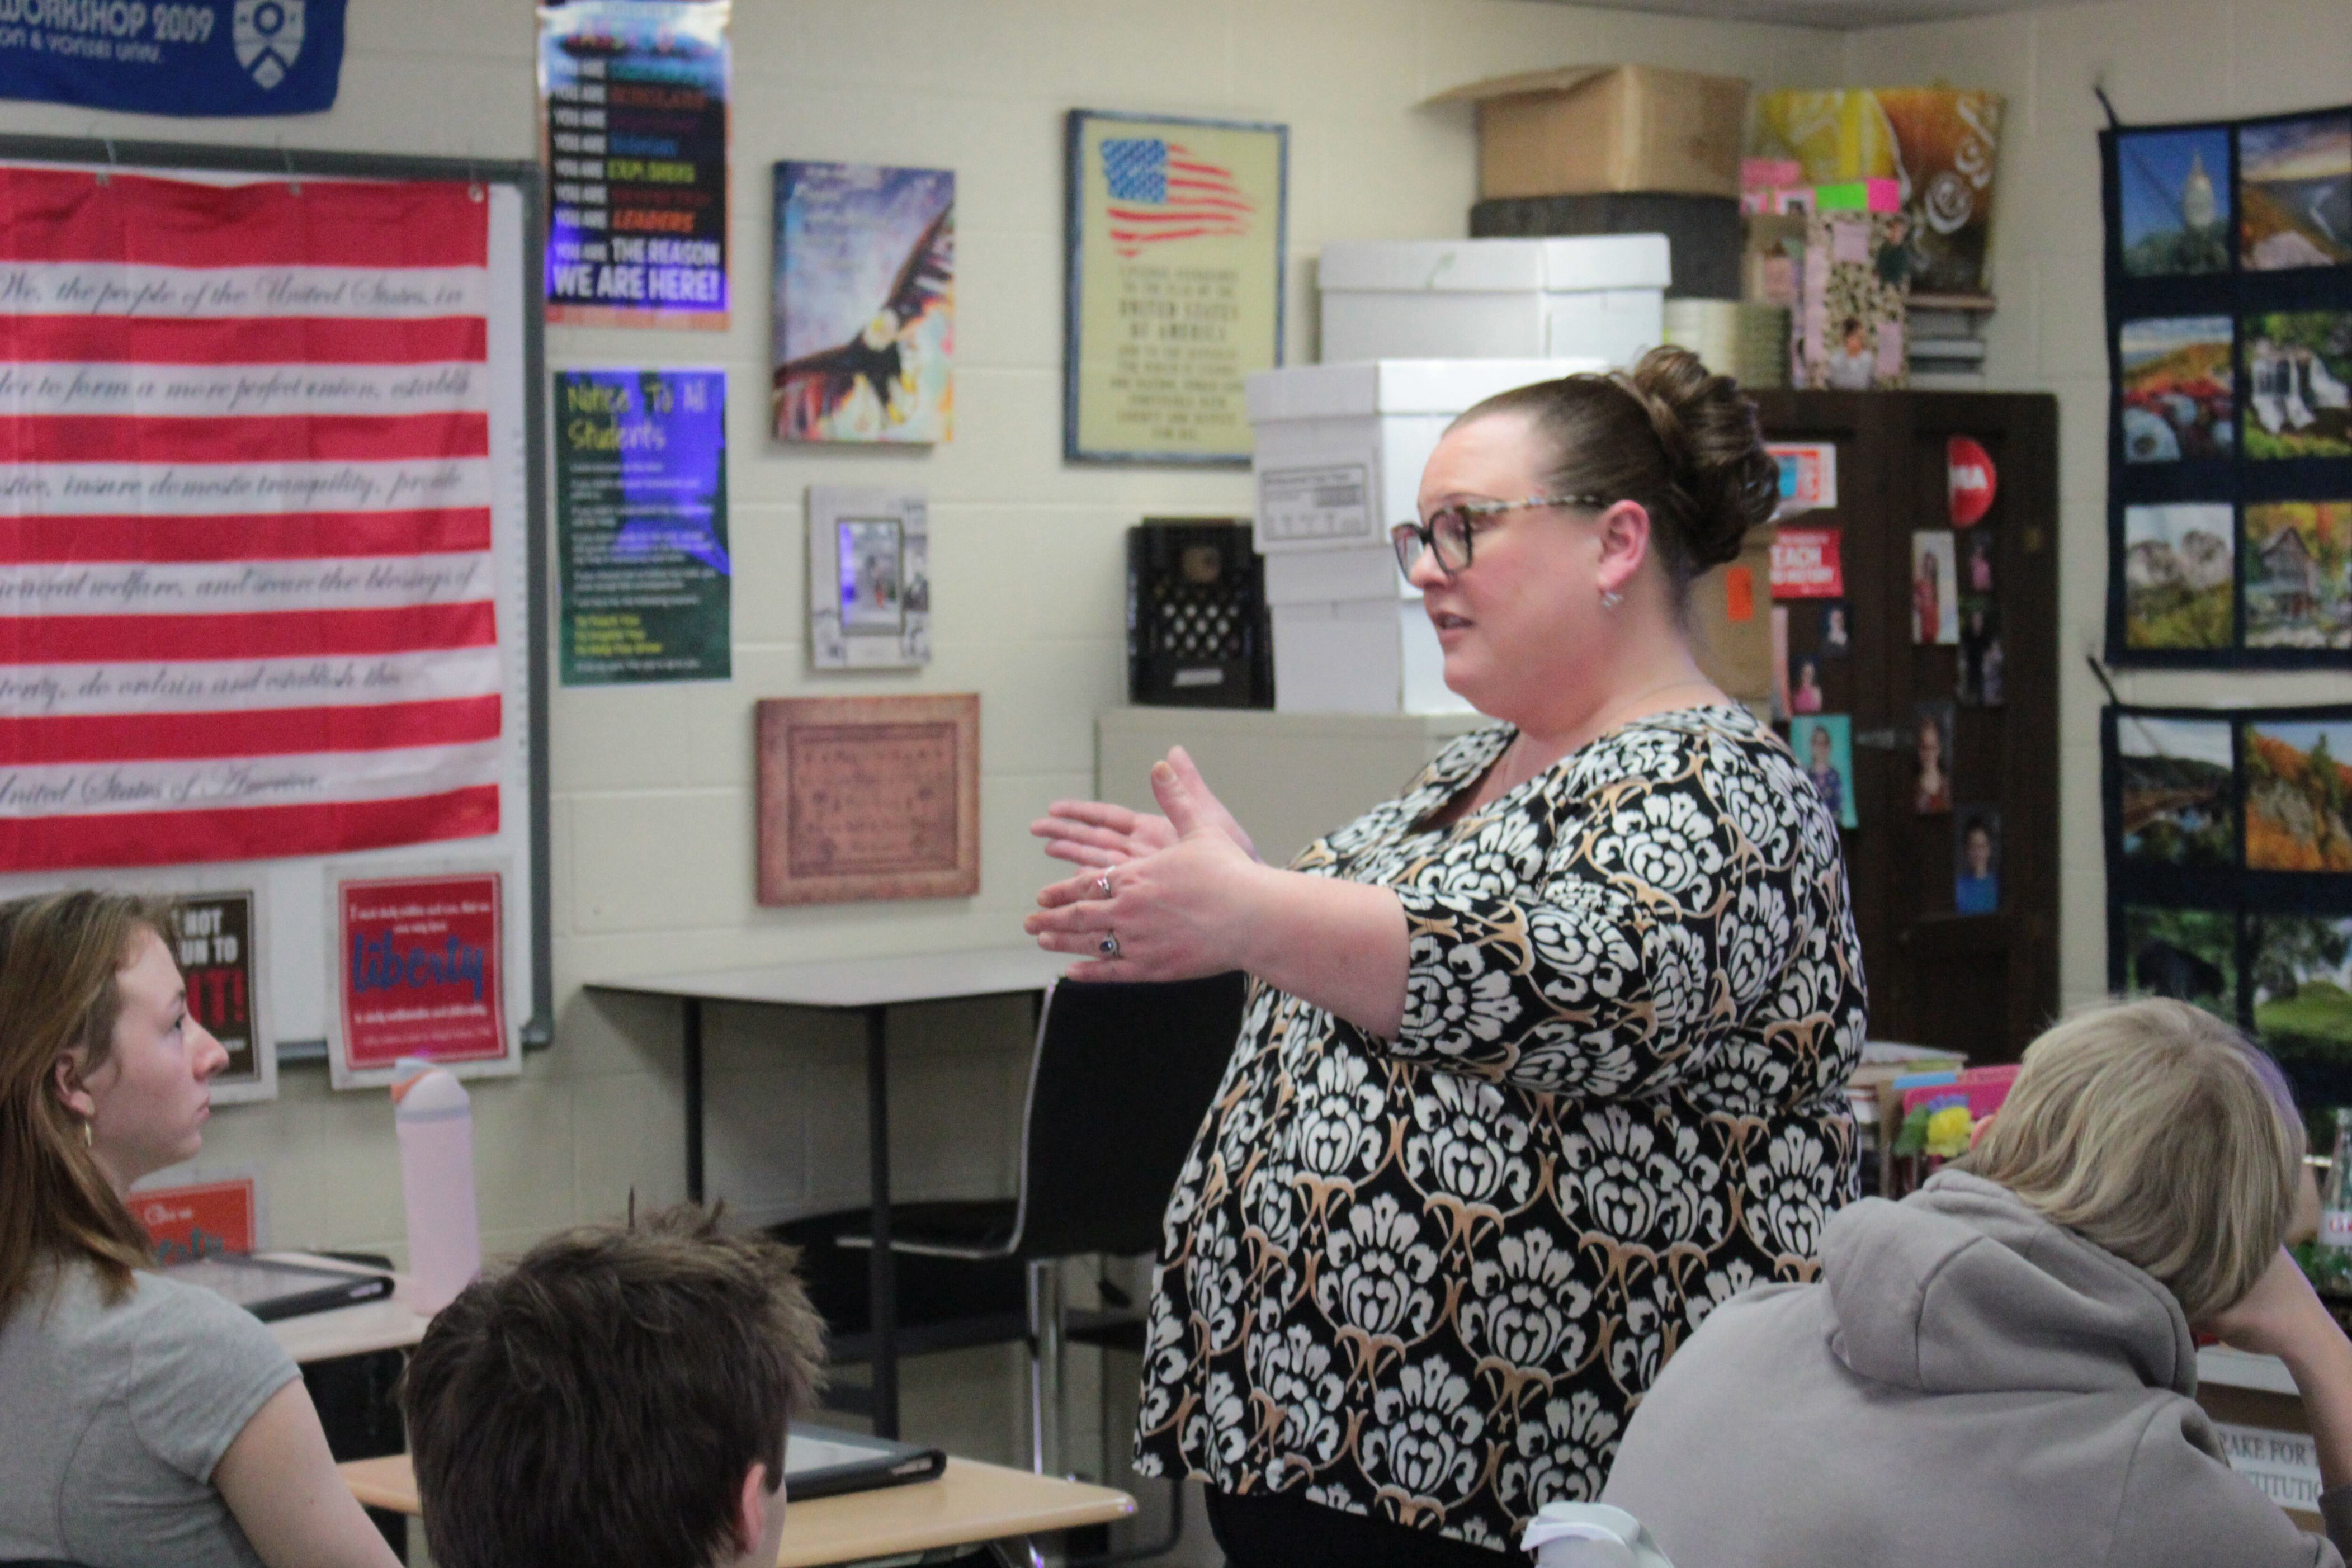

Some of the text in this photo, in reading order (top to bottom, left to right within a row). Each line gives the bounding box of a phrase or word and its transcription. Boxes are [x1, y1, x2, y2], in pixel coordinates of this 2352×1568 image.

[153, 4, 214, 43] 2009
[612, 237, 644, 263] THE
[648, 239, 720, 266] REASON
[92, 280, 175, 315] people
[211, 280, 247, 304] the
[254, 274, 347, 305] United
[554, 265, 720, 302] WE ARE HERE!
[62, 367, 128, 405] form
[138, 382, 154, 398] a
[168, 382, 230, 398] more
[226, 372, 303, 411] perfect
[645, 381, 673, 414] To
[568, 417, 667, 450] Students
[149, 471, 252, 497] domestic
[195, 568, 255, 595] and
[318, 565, 359, 593] the
[212, 665, 265, 695] and
[81, 769, 163, 804] States
[212, 934, 238, 964] TO
[352, 932, 484, 1001] liberty
[2270, 1438, 2306, 1467] FOR
